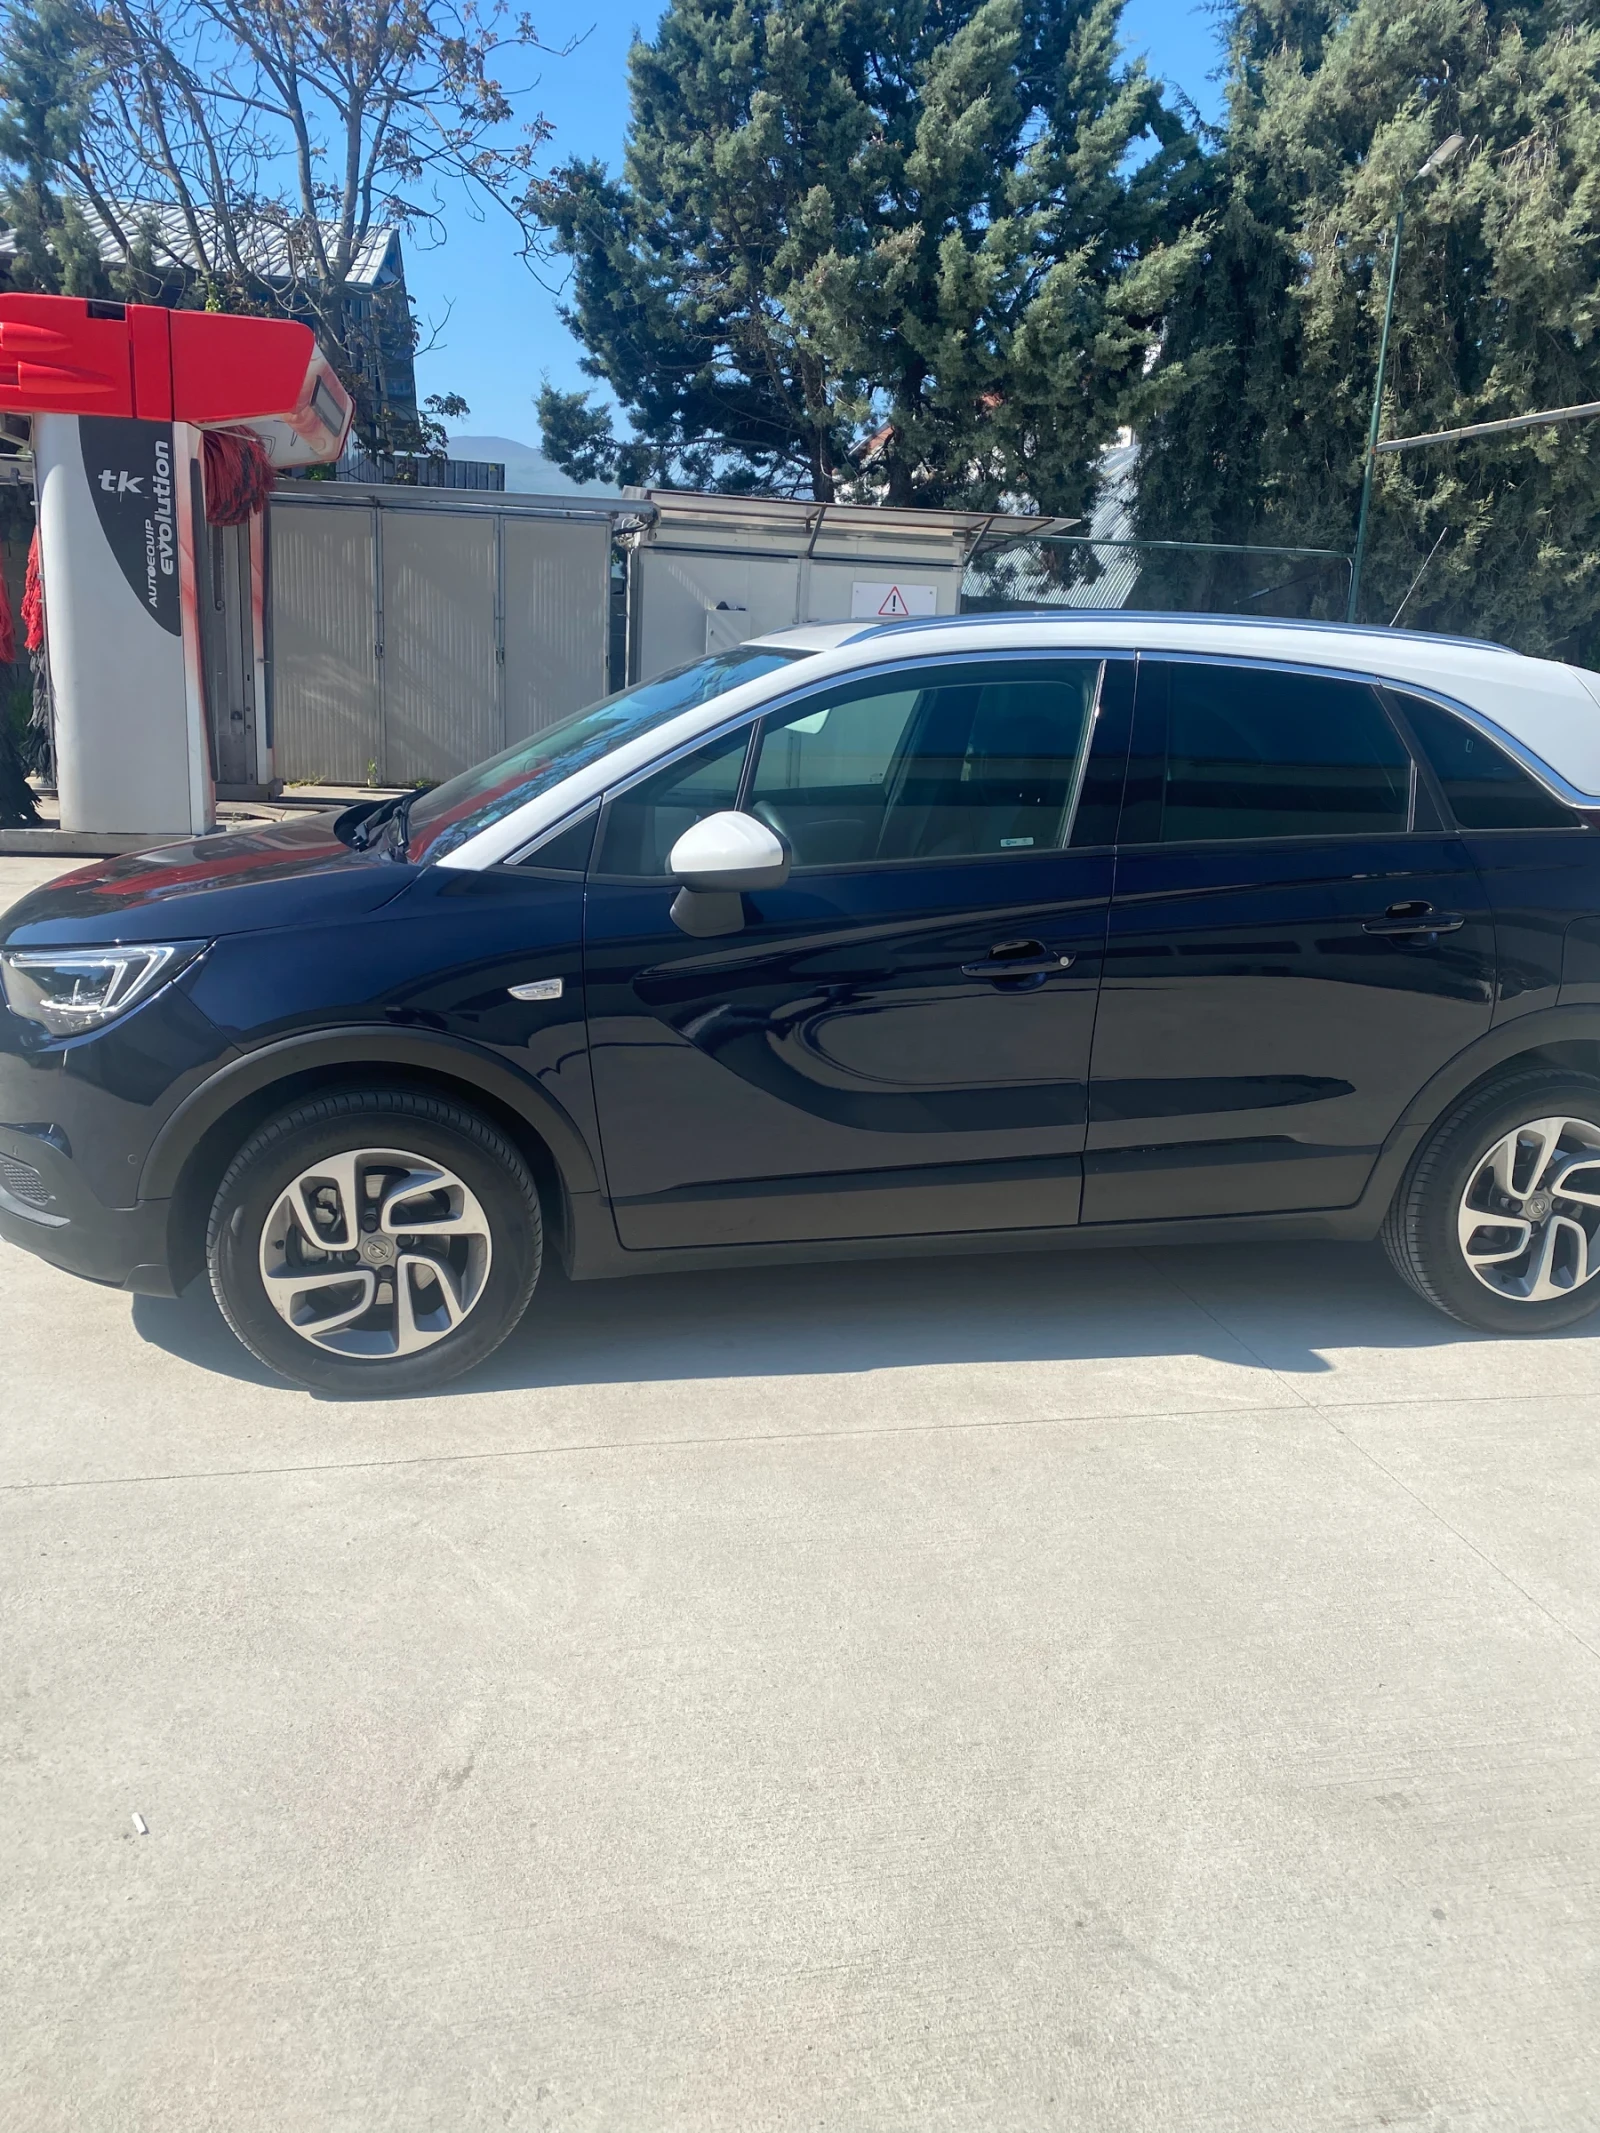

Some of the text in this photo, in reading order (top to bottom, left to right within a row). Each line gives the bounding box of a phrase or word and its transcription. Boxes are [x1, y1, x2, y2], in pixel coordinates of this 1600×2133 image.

[98, 469, 144, 494] tk
[153, 440, 174, 575] evolution
[145, 519, 158, 608] AUTOEQUIP
